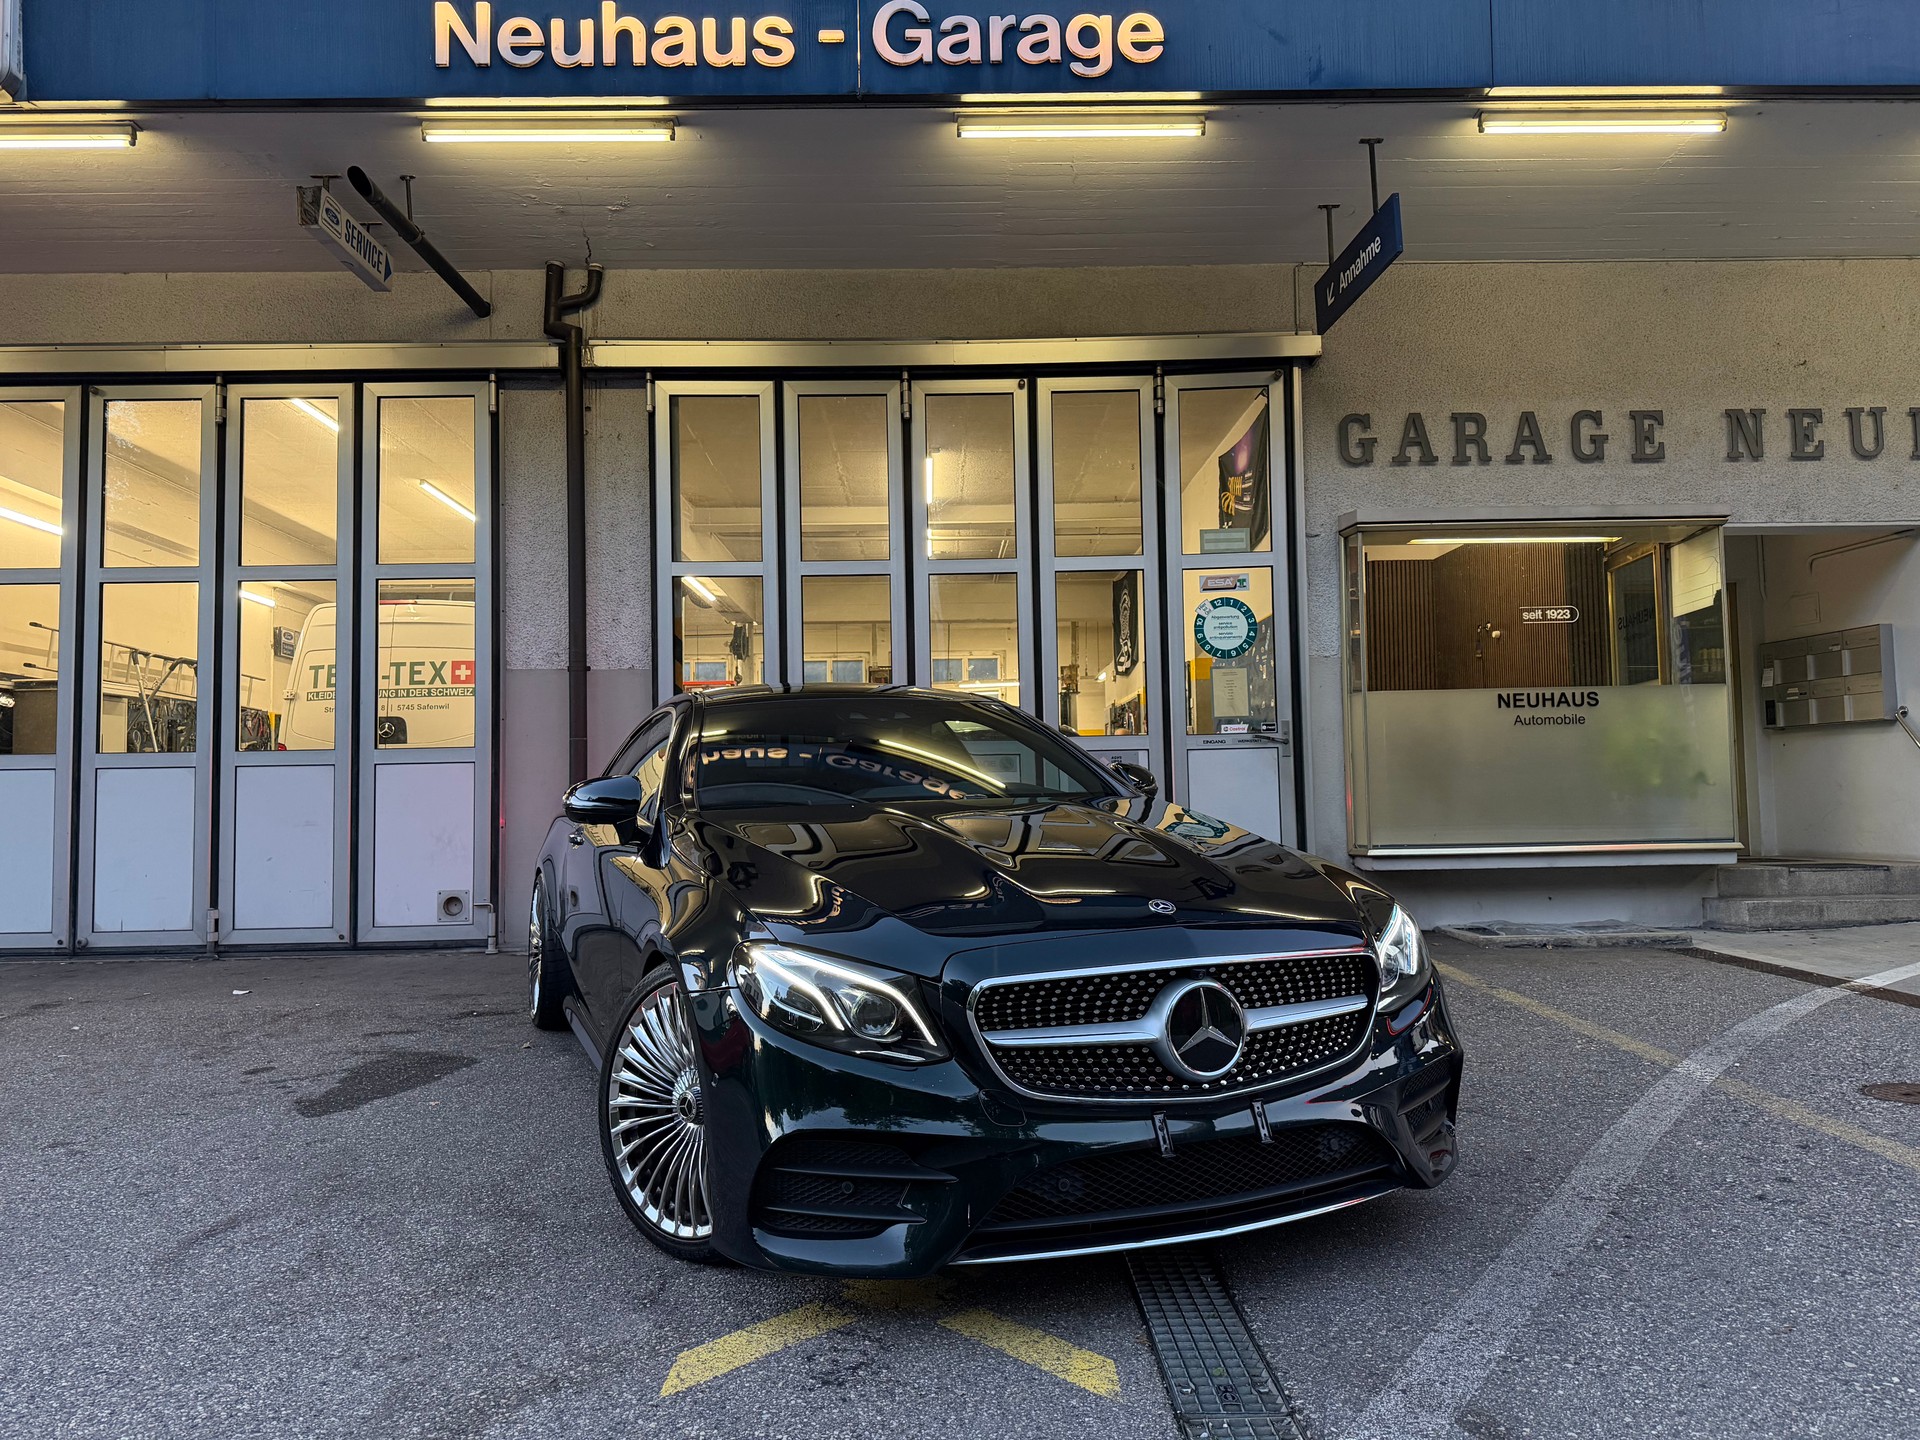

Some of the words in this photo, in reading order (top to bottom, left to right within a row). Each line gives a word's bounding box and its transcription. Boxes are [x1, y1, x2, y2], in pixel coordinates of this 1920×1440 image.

[434, 0, 796, 68] Neuhaus
[818, 29, 844, 44] -
[872, 0, 1165, 79] Garage
[344, 218, 383, 274] SERVICE
[1339, 236, 1381, 294] Annahme
[1337, 408, 1666, 466] GARAGE
[1724, 406, 1920, 461] NEU
[1521, 609, 1543, 621] seit
[1545, 609, 1571, 621] 1923
[398, 688, 407, 698] IN
[409, 688, 429, 697] DER
[430, 687, 474, 697] SCHWEIZ
[1497, 691, 1600, 709] NEUHAUS
[416, 703, 450, 711] Safenwil
[1513, 713, 1586, 726] Automobile
